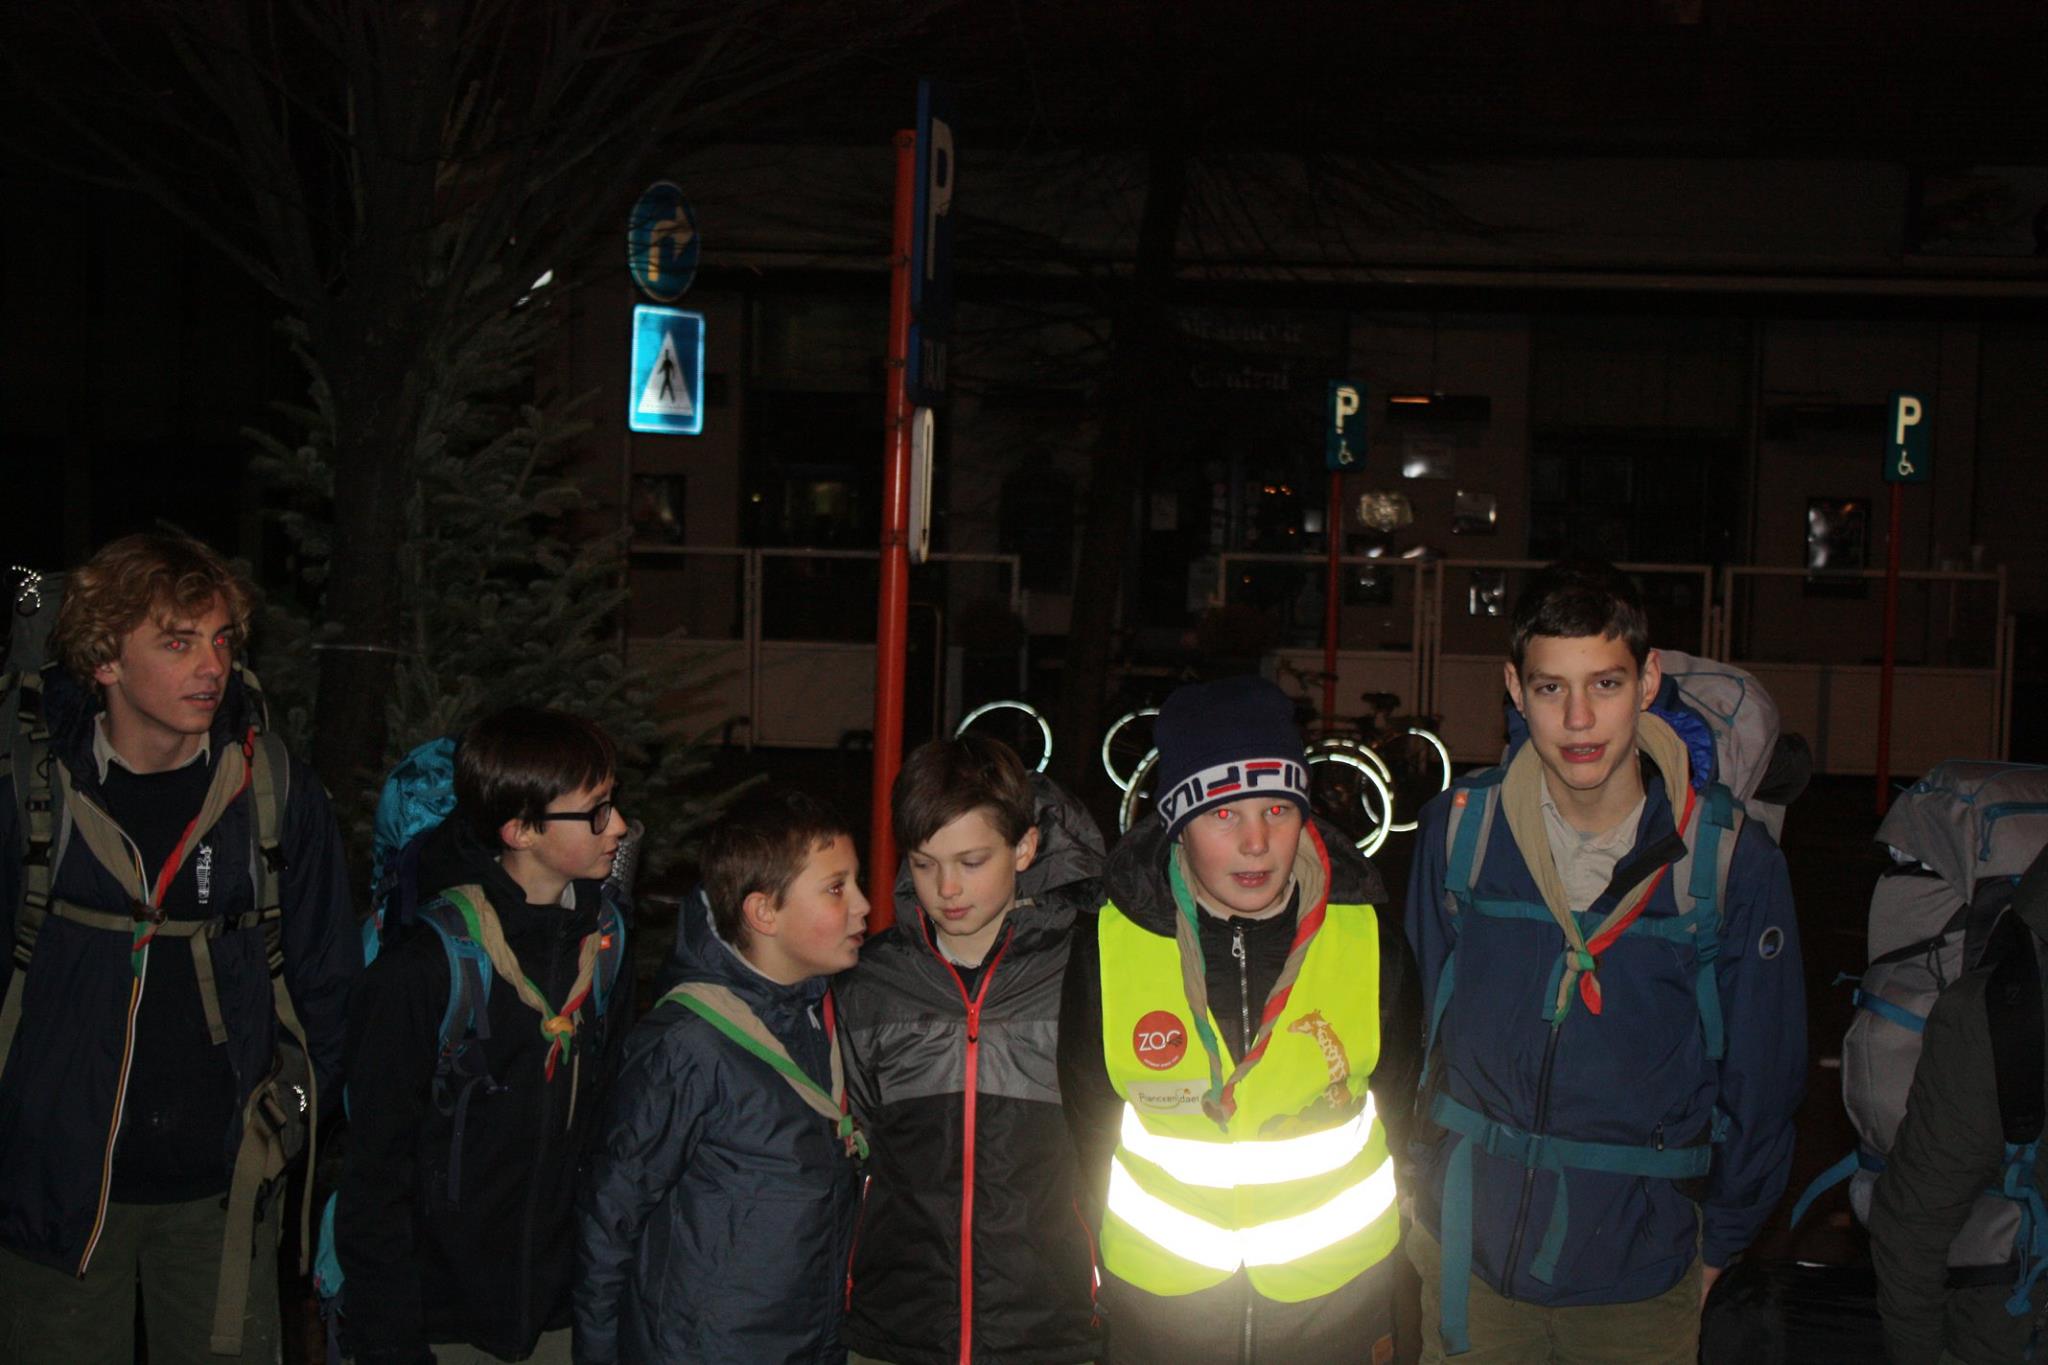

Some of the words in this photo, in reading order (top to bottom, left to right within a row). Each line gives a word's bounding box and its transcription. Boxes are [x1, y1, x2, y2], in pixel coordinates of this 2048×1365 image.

[927, 117, 955, 281] P
[1335, 384, 1361, 435] P
[1896, 394, 1923, 445] P
